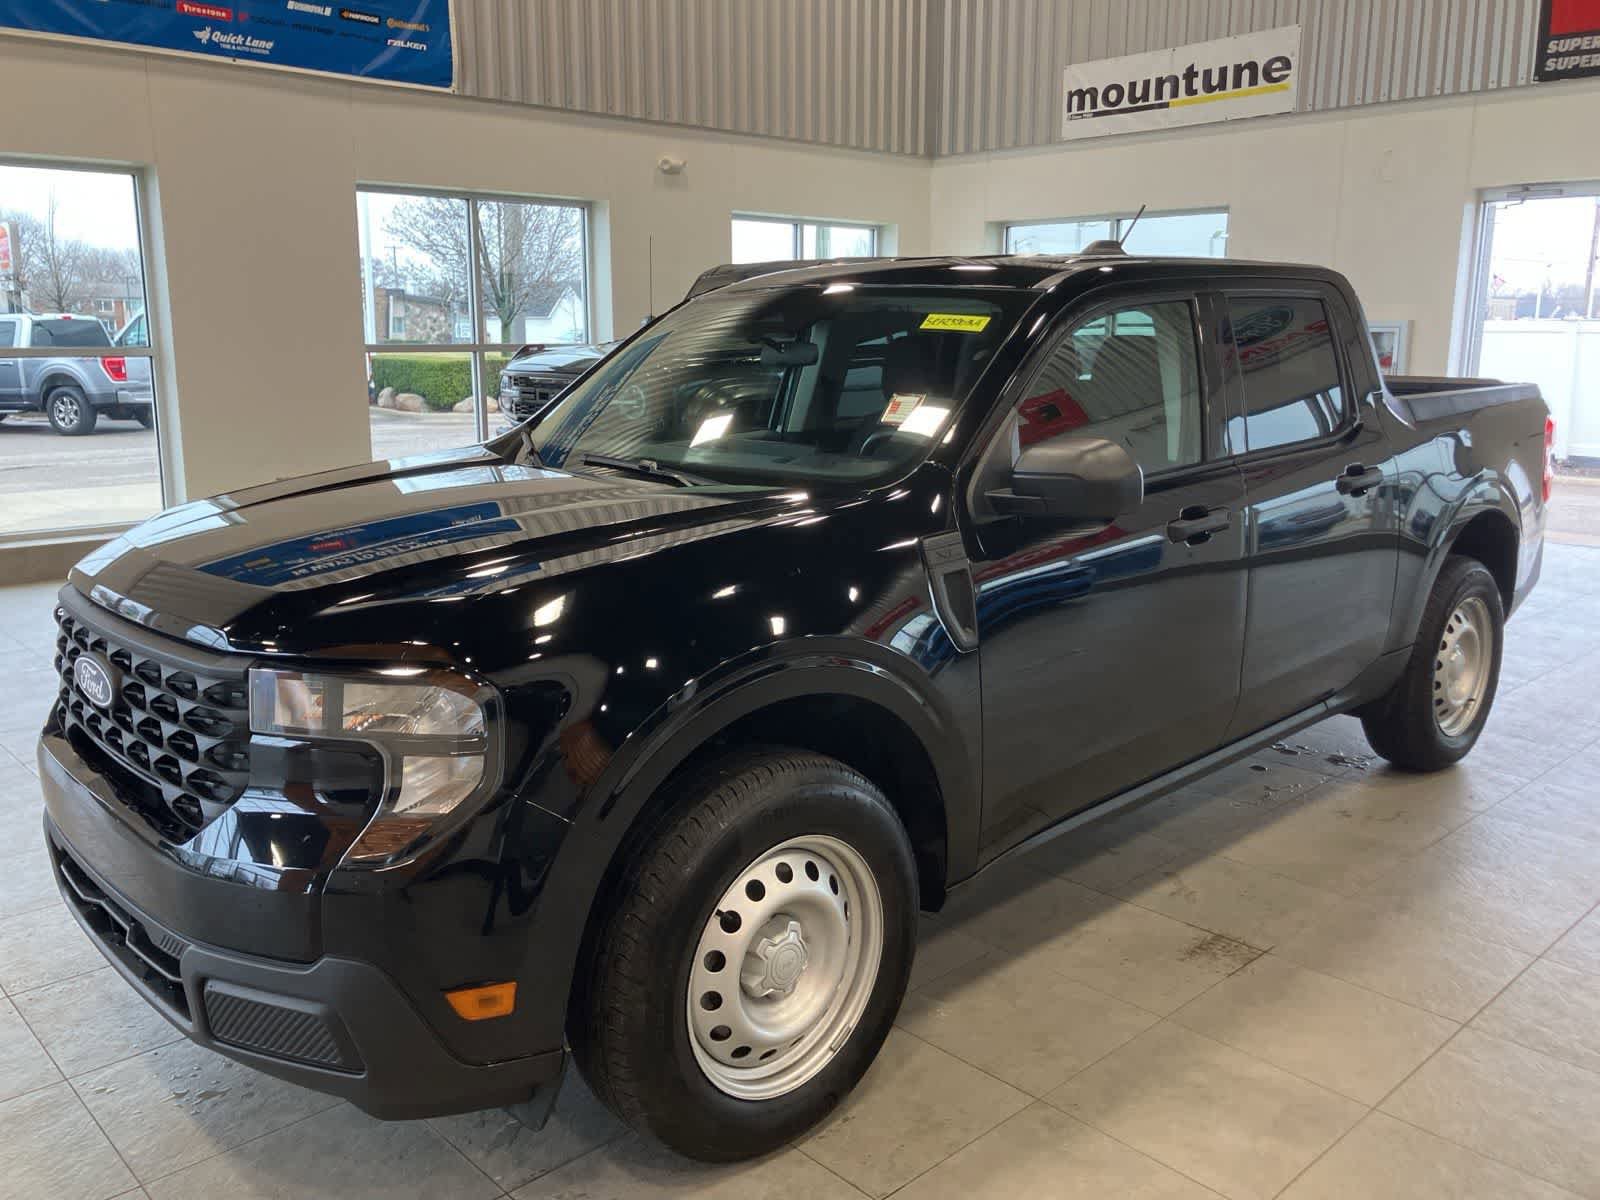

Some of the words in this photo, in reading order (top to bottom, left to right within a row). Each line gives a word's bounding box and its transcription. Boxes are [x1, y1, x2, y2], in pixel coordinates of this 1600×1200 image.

[211, 30, 245, 45] Quick
[245, 35, 274, 50] Lane
[387, 38, 427, 51] FALKEN
[1066, 55, 1292, 113] mountune
[80, 662, 105, 700] Ford
